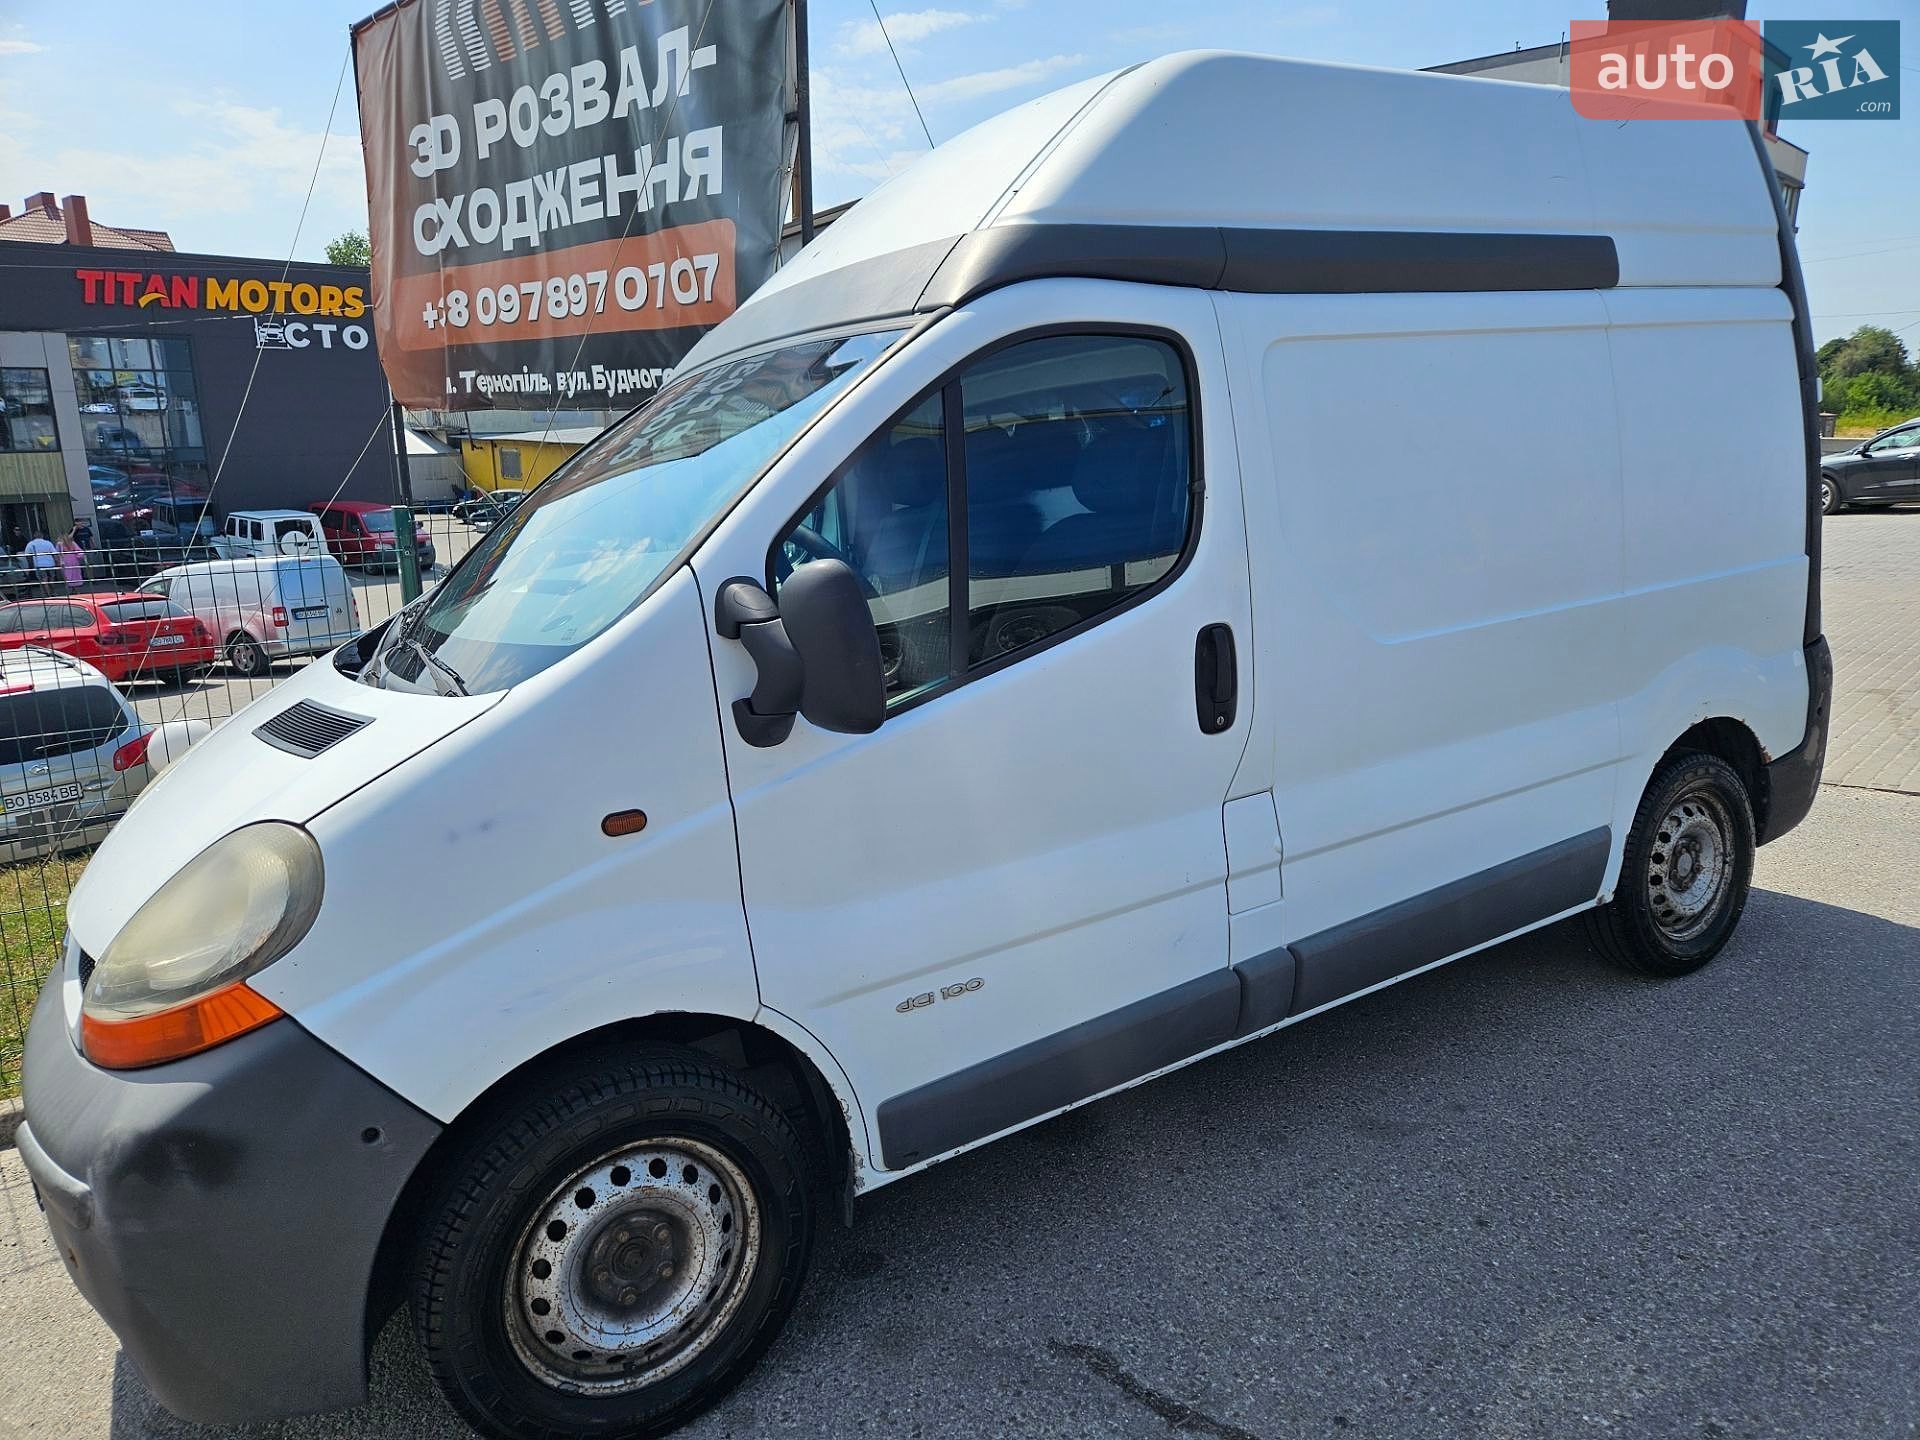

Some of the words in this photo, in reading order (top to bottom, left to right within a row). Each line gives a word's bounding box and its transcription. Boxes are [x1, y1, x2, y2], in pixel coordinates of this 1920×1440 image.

[473, 24, 717, 160] РОЗВАЛ-
[413, 125, 723, 256] СХОДЖЕННЯ
[76, 269, 198, 309] TITAN
[206, 277, 365, 319] MOTORS
[286, 322, 369, 350] СТО
[459, 364, 552, 399] Тернопіль,
[556, 371, 591, 399] вул.
[5, 796, 25, 810] BO
[60, 785, 79, 798] BB
[940, 977, 985, 1000] 100
